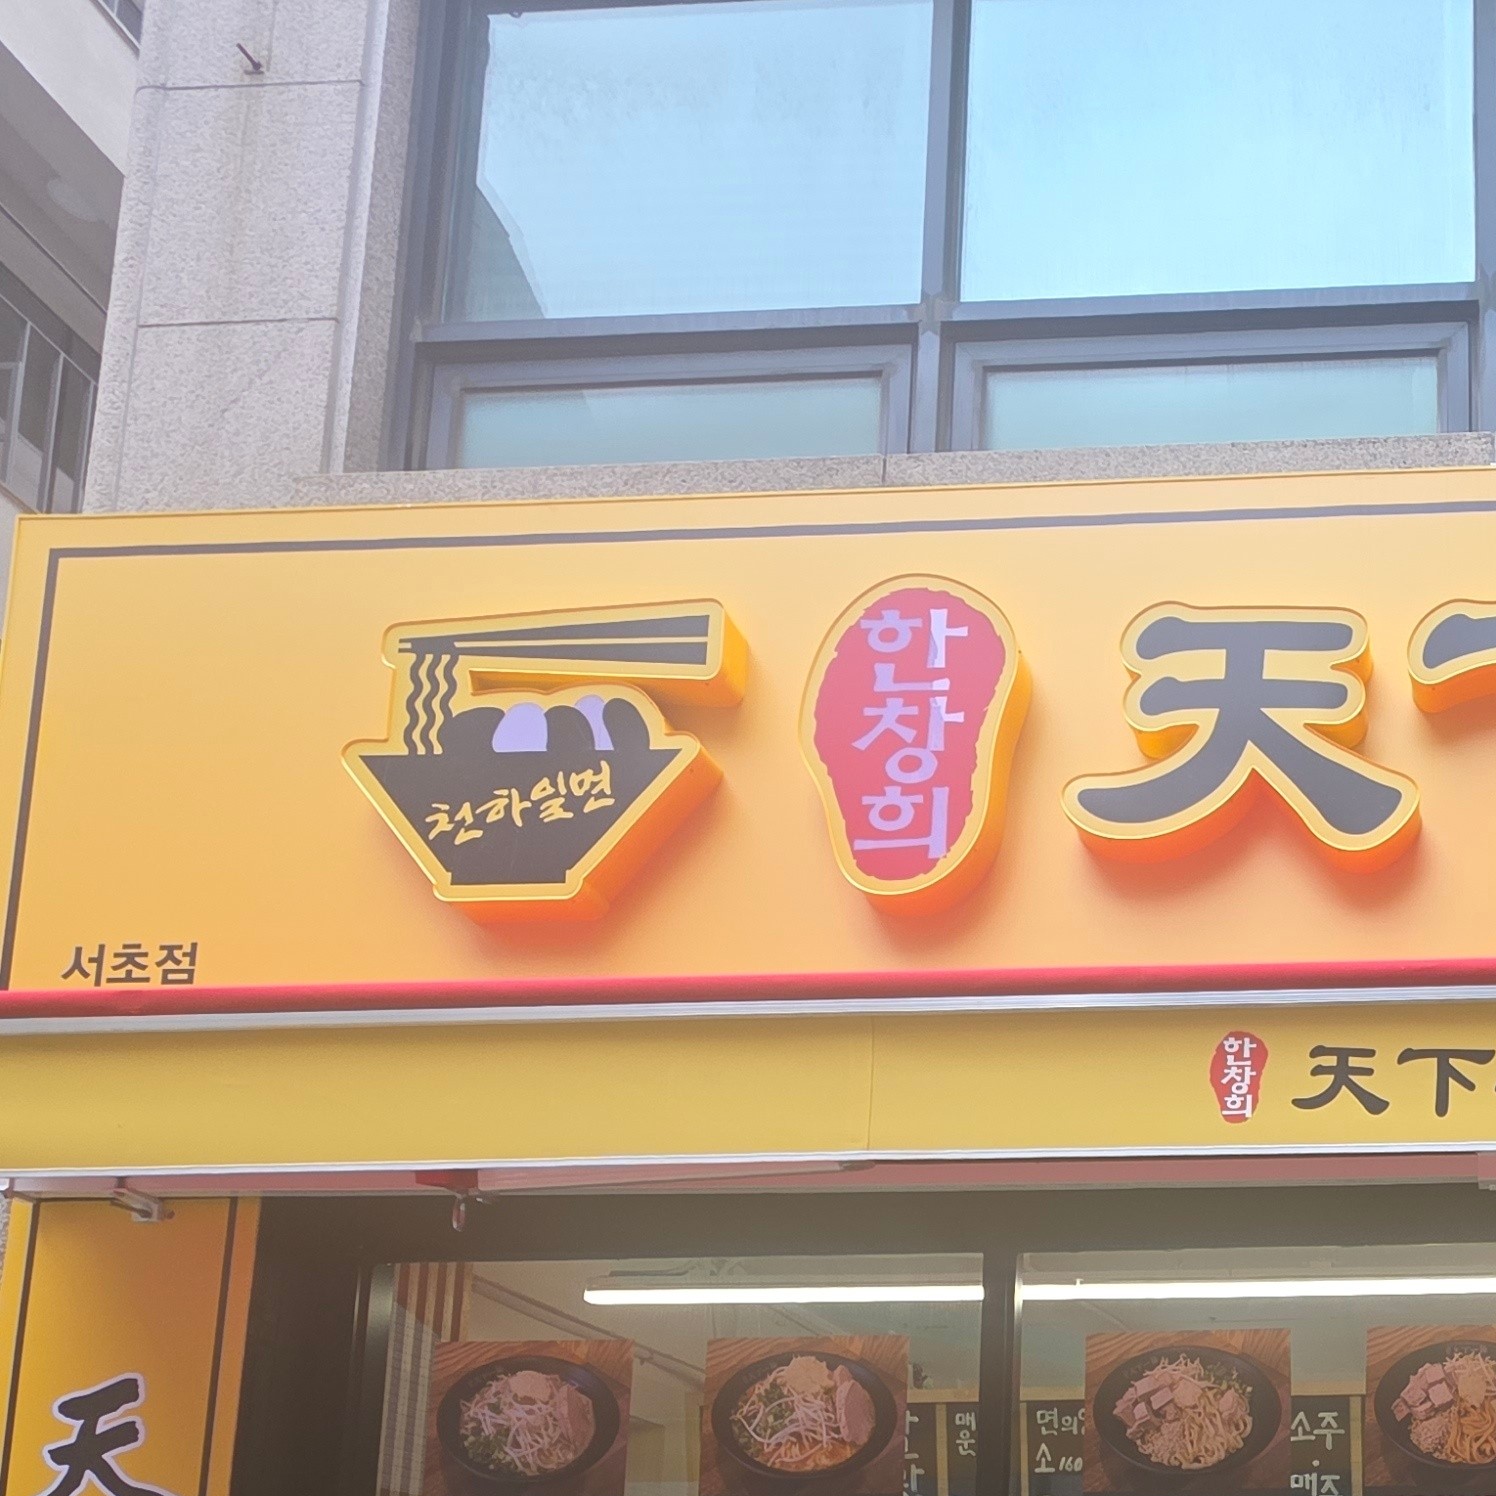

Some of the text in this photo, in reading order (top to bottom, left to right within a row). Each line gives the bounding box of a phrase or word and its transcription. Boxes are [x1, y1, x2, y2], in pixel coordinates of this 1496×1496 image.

[853, 608, 968, 859] 한창희
[425, 761, 616, 845] 천하일면
[61, 941, 199, 987] 서초점
[1221, 1037, 1257, 1118] 한창희
[1291, 1411, 1345, 1450] 소주
